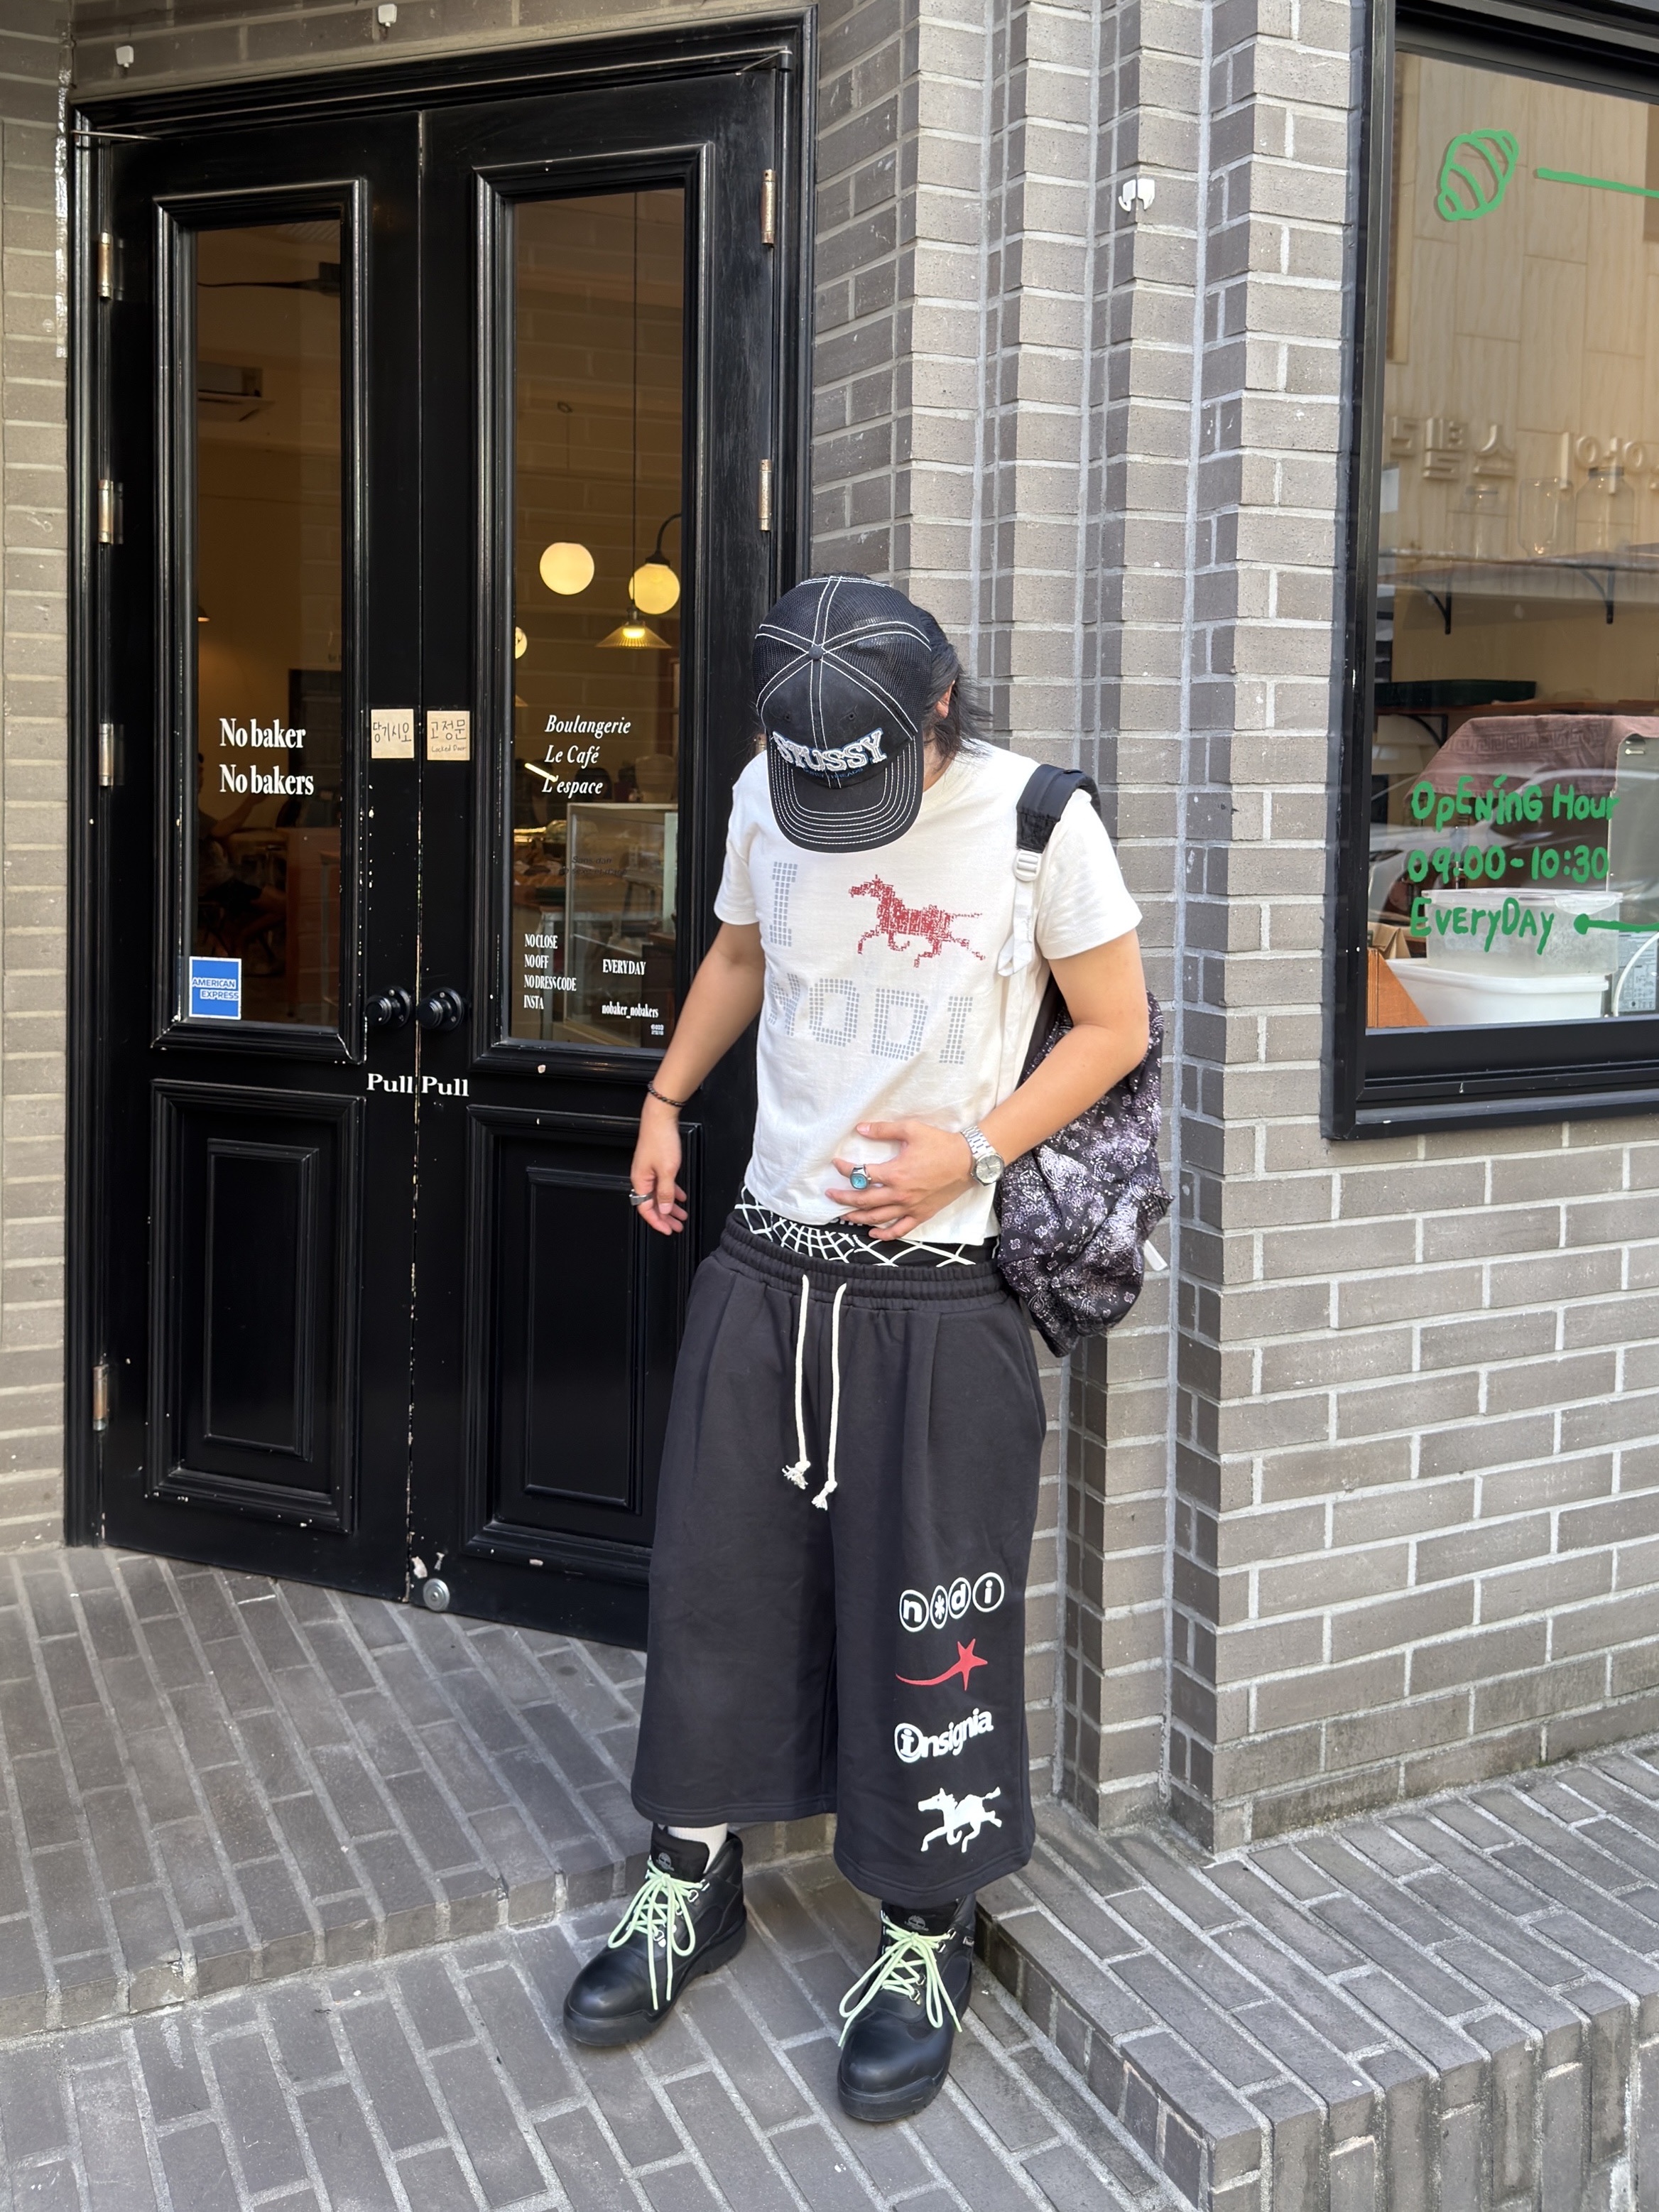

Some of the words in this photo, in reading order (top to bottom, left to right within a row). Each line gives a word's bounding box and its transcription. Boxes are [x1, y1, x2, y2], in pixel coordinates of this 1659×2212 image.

[219, 717, 248, 747] No
[250, 718, 306, 749] baker
[373, 722, 412, 743] 당기시오
[430, 720, 467, 740] 고정문
[544, 715, 631, 739] Boulangerie
[431, 744, 452, 753] Locked
[544, 744, 563, 763] Le
[567, 745, 600, 769] Café
[219, 764, 248, 793] No
[250, 764, 315, 796] bakers
[524, 933, 535, 948] NO
[535, 934, 558, 949] CLOSE
[524, 954, 535, 968] NO
[535, 955, 550, 969] OFF
[192, 978, 235, 988] AMERICAN
[523, 975, 535, 988] NO
[535, 975, 557, 990] DRESS
[557, 977, 577, 992] CODE
[201, 990, 239, 1000] EXPRESS
[523, 994, 544, 1009] INSTA
[602, 1001, 659, 1019] nobaker_nobakers
[366, 1073, 413, 1094] Pull
[421, 1075, 469, 1097] Pull
